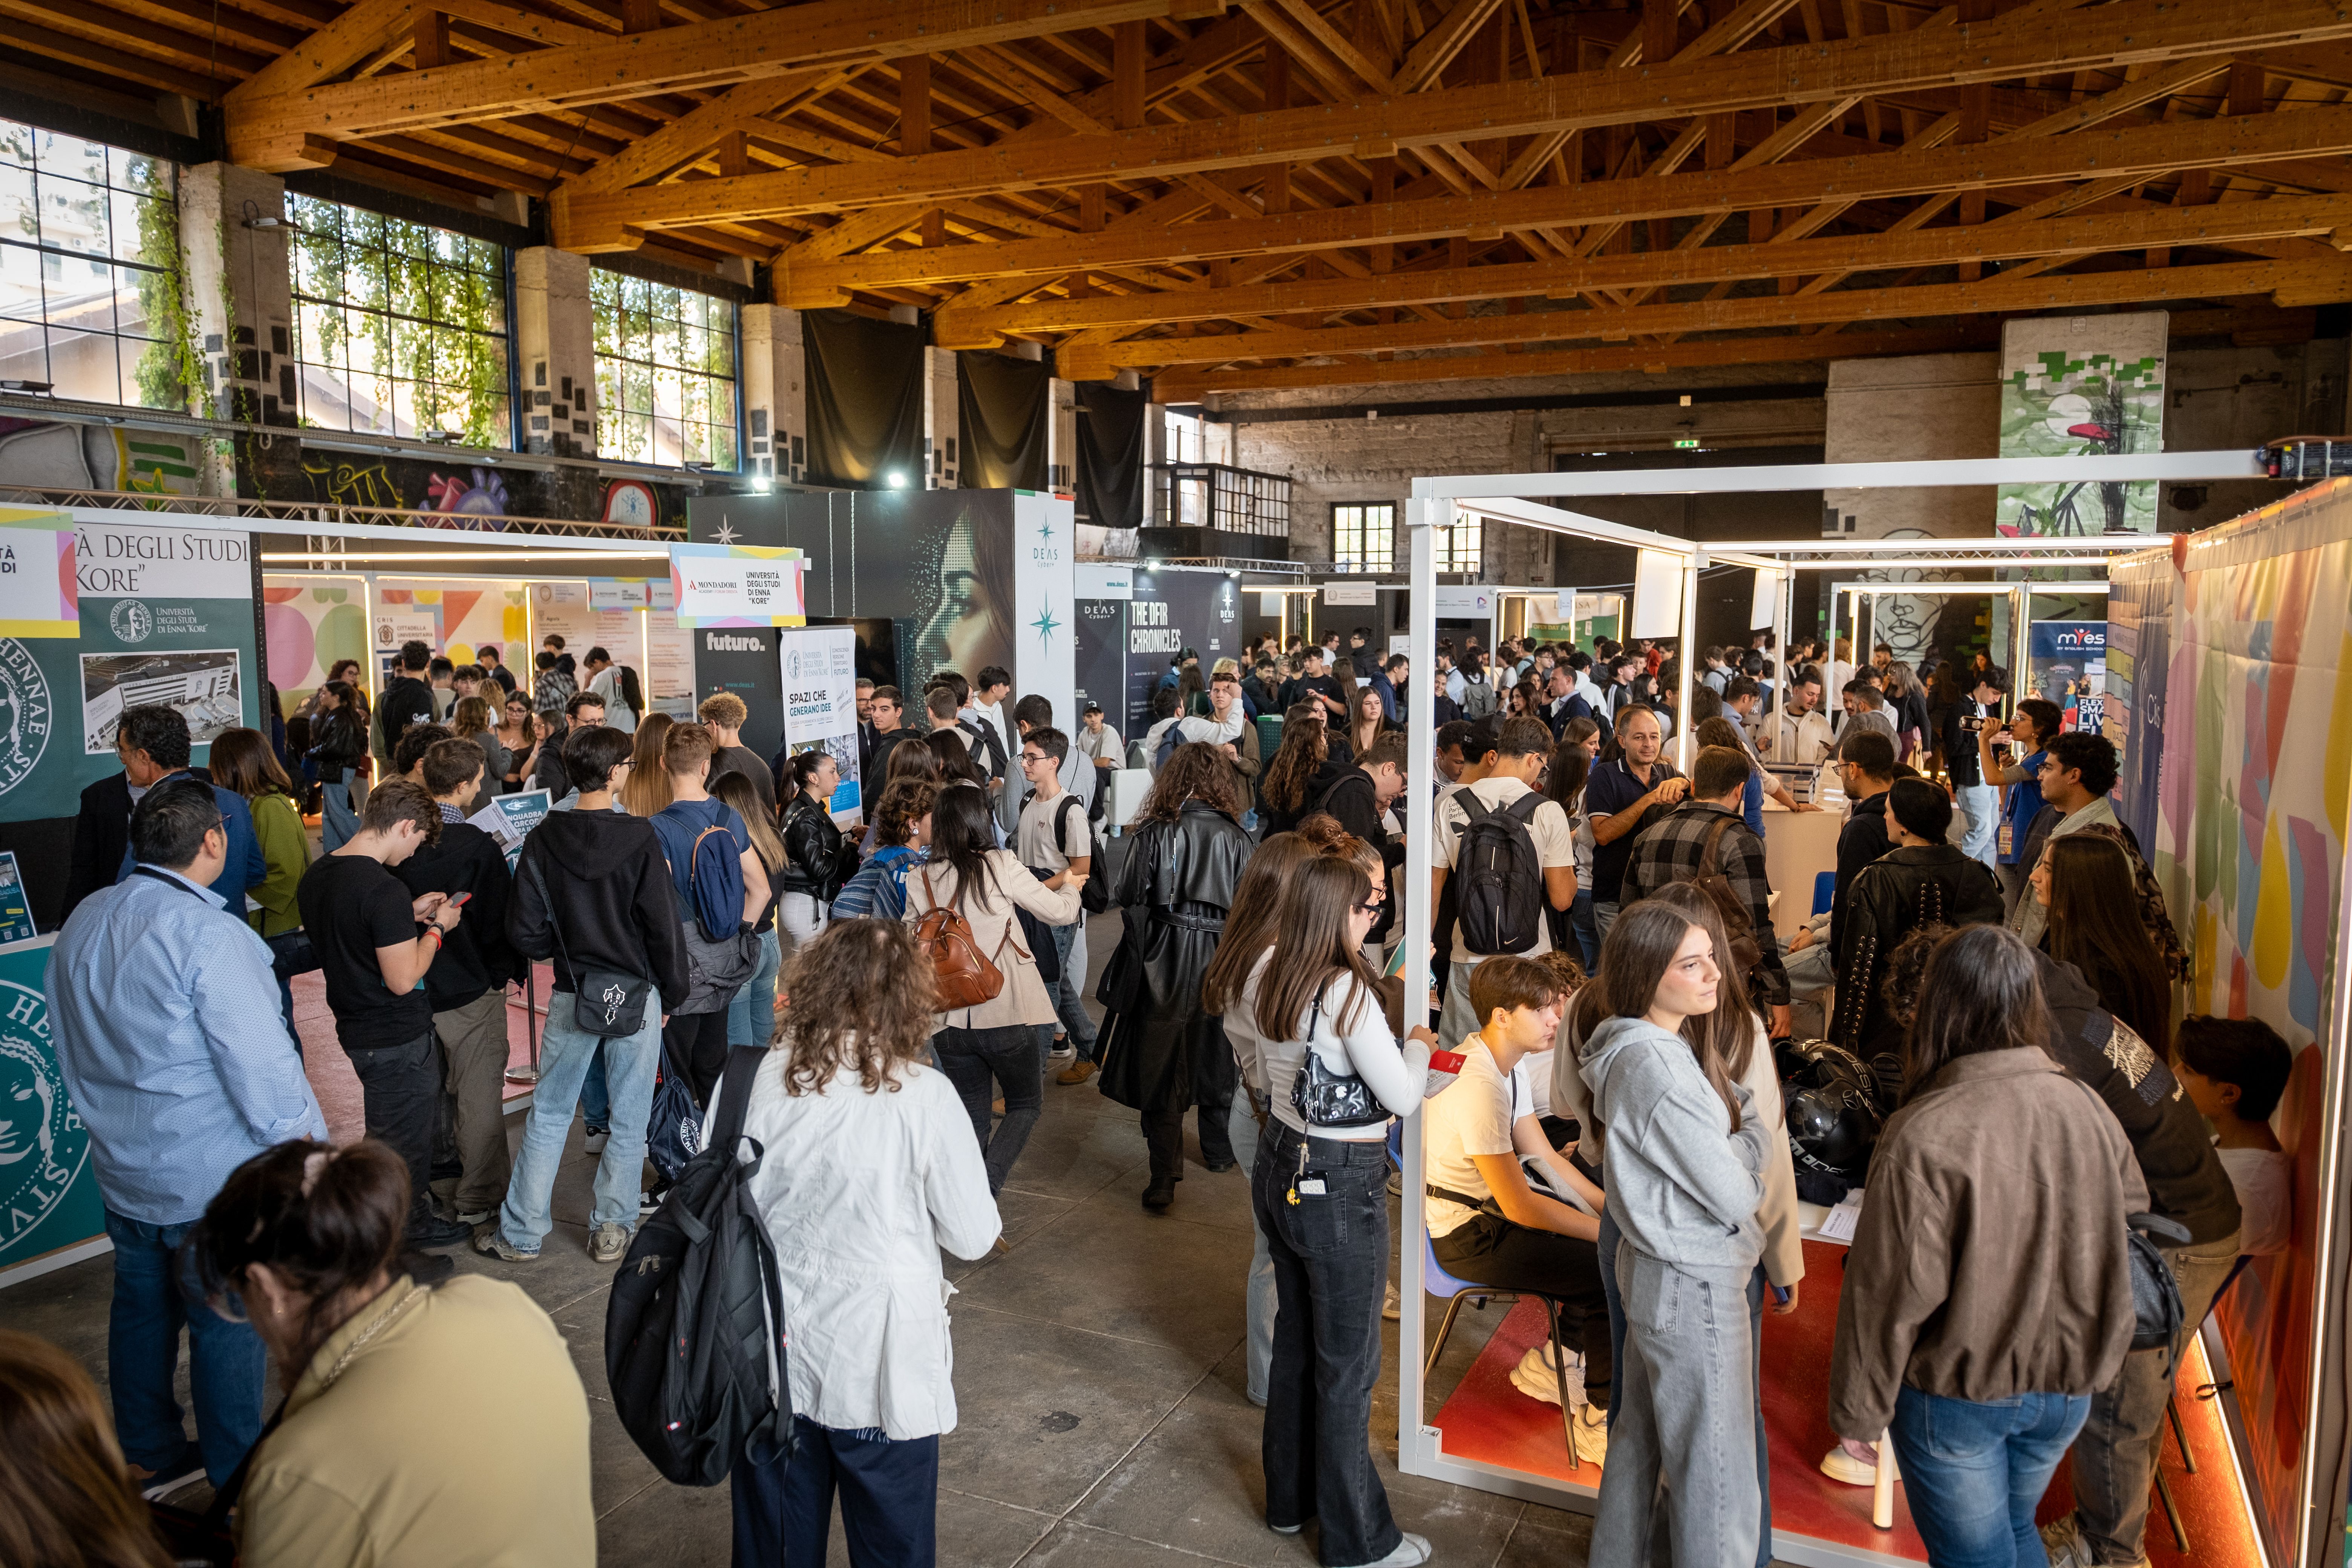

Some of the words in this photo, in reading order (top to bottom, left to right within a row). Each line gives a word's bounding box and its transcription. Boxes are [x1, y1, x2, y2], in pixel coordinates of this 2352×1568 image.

[105, 535, 174, 559] DEGLI
[183, 534, 248, 562] STUDI
[1034, 547, 1058, 560] DEAS
[746, 570, 780, 579] UNIVERSITÀ
[156, 606, 194, 616] UNIVERSITÀ
[1084, 606, 1115, 614] DEAS
[1131, 602, 1148, 626] THE
[1149, 602, 1168, 626] DFIR
[707, 632, 766, 651] futuro.
[1130, 629, 1181, 654] CHRONICLES
[789, 692, 811, 704] SPAZI
[813, 690, 826, 701] CHE
[790, 704, 819, 717] GENERANO
[821, 703, 831, 712] IDEE
[2080, 706, 2104, 714] SMA
[2079, 714, 2104, 726] LIV
[508, 811, 543, 821] NQUADRA
